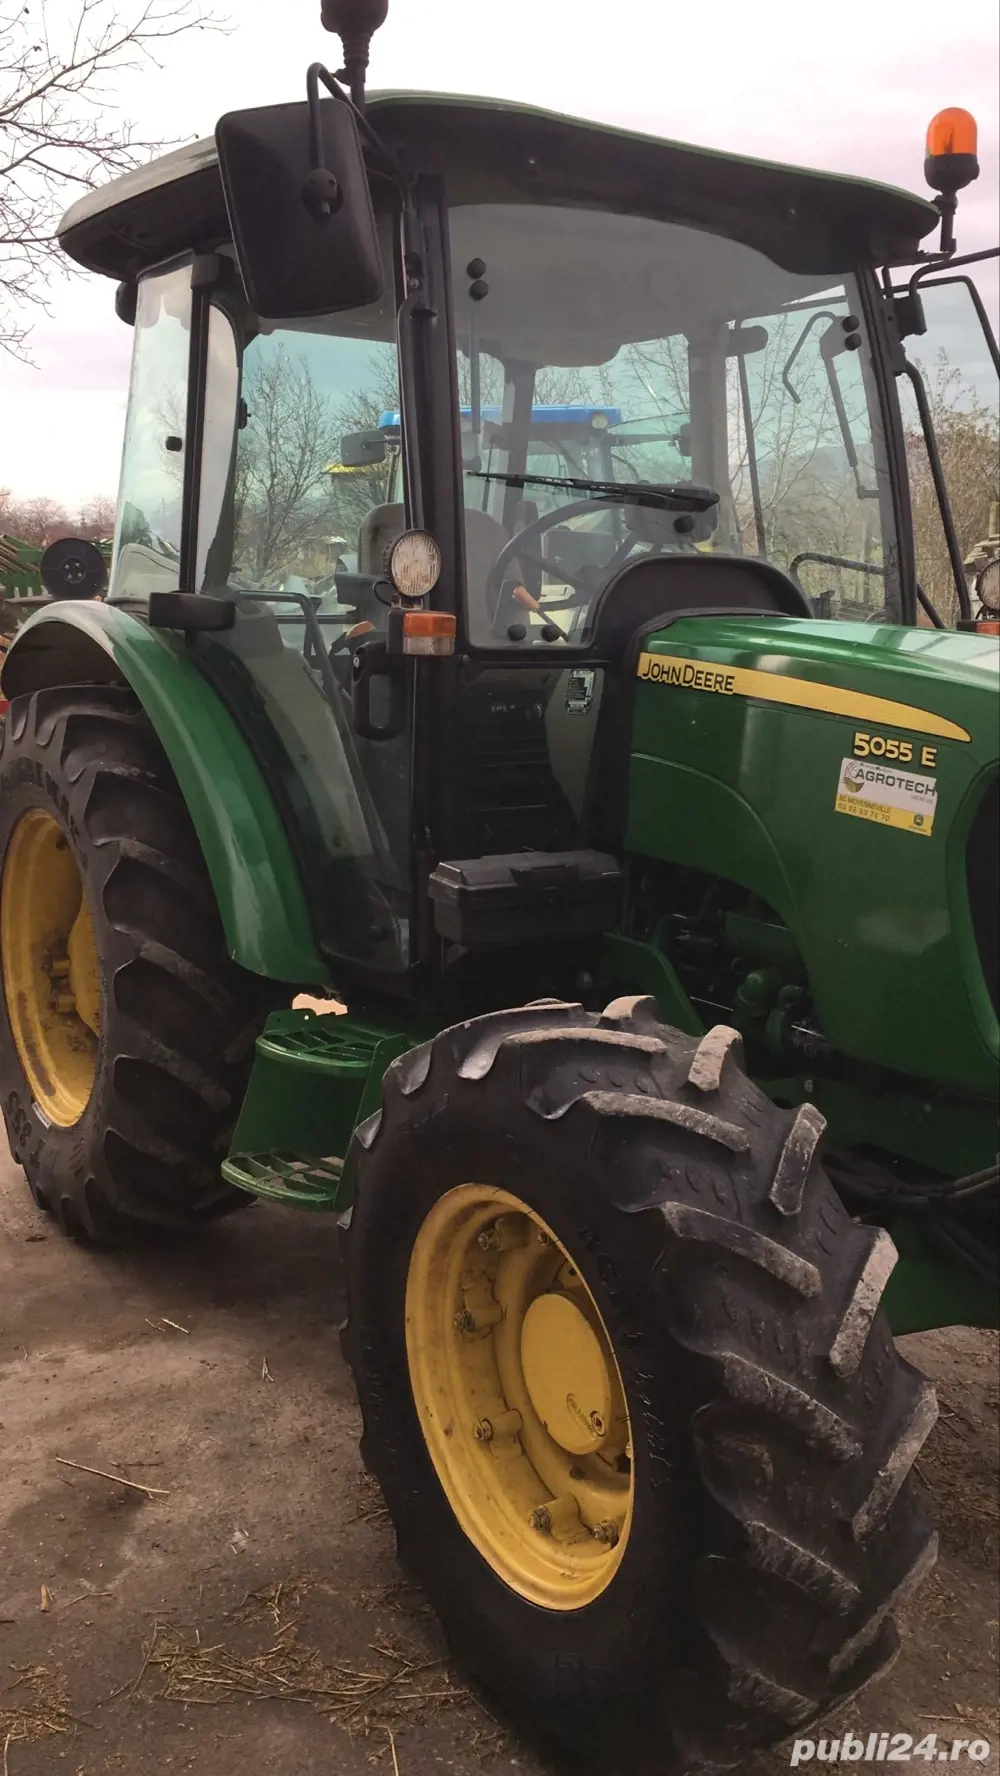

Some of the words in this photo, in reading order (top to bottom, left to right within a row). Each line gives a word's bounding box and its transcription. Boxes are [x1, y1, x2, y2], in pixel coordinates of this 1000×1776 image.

[643, 659, 681, 682] JOHN
[683, 664, 735, 692] DEERE
[853, 732, 913, 762] 5055
[921, 746, 937, 767] E
[855, 769, 936, 796] AGROTECH
